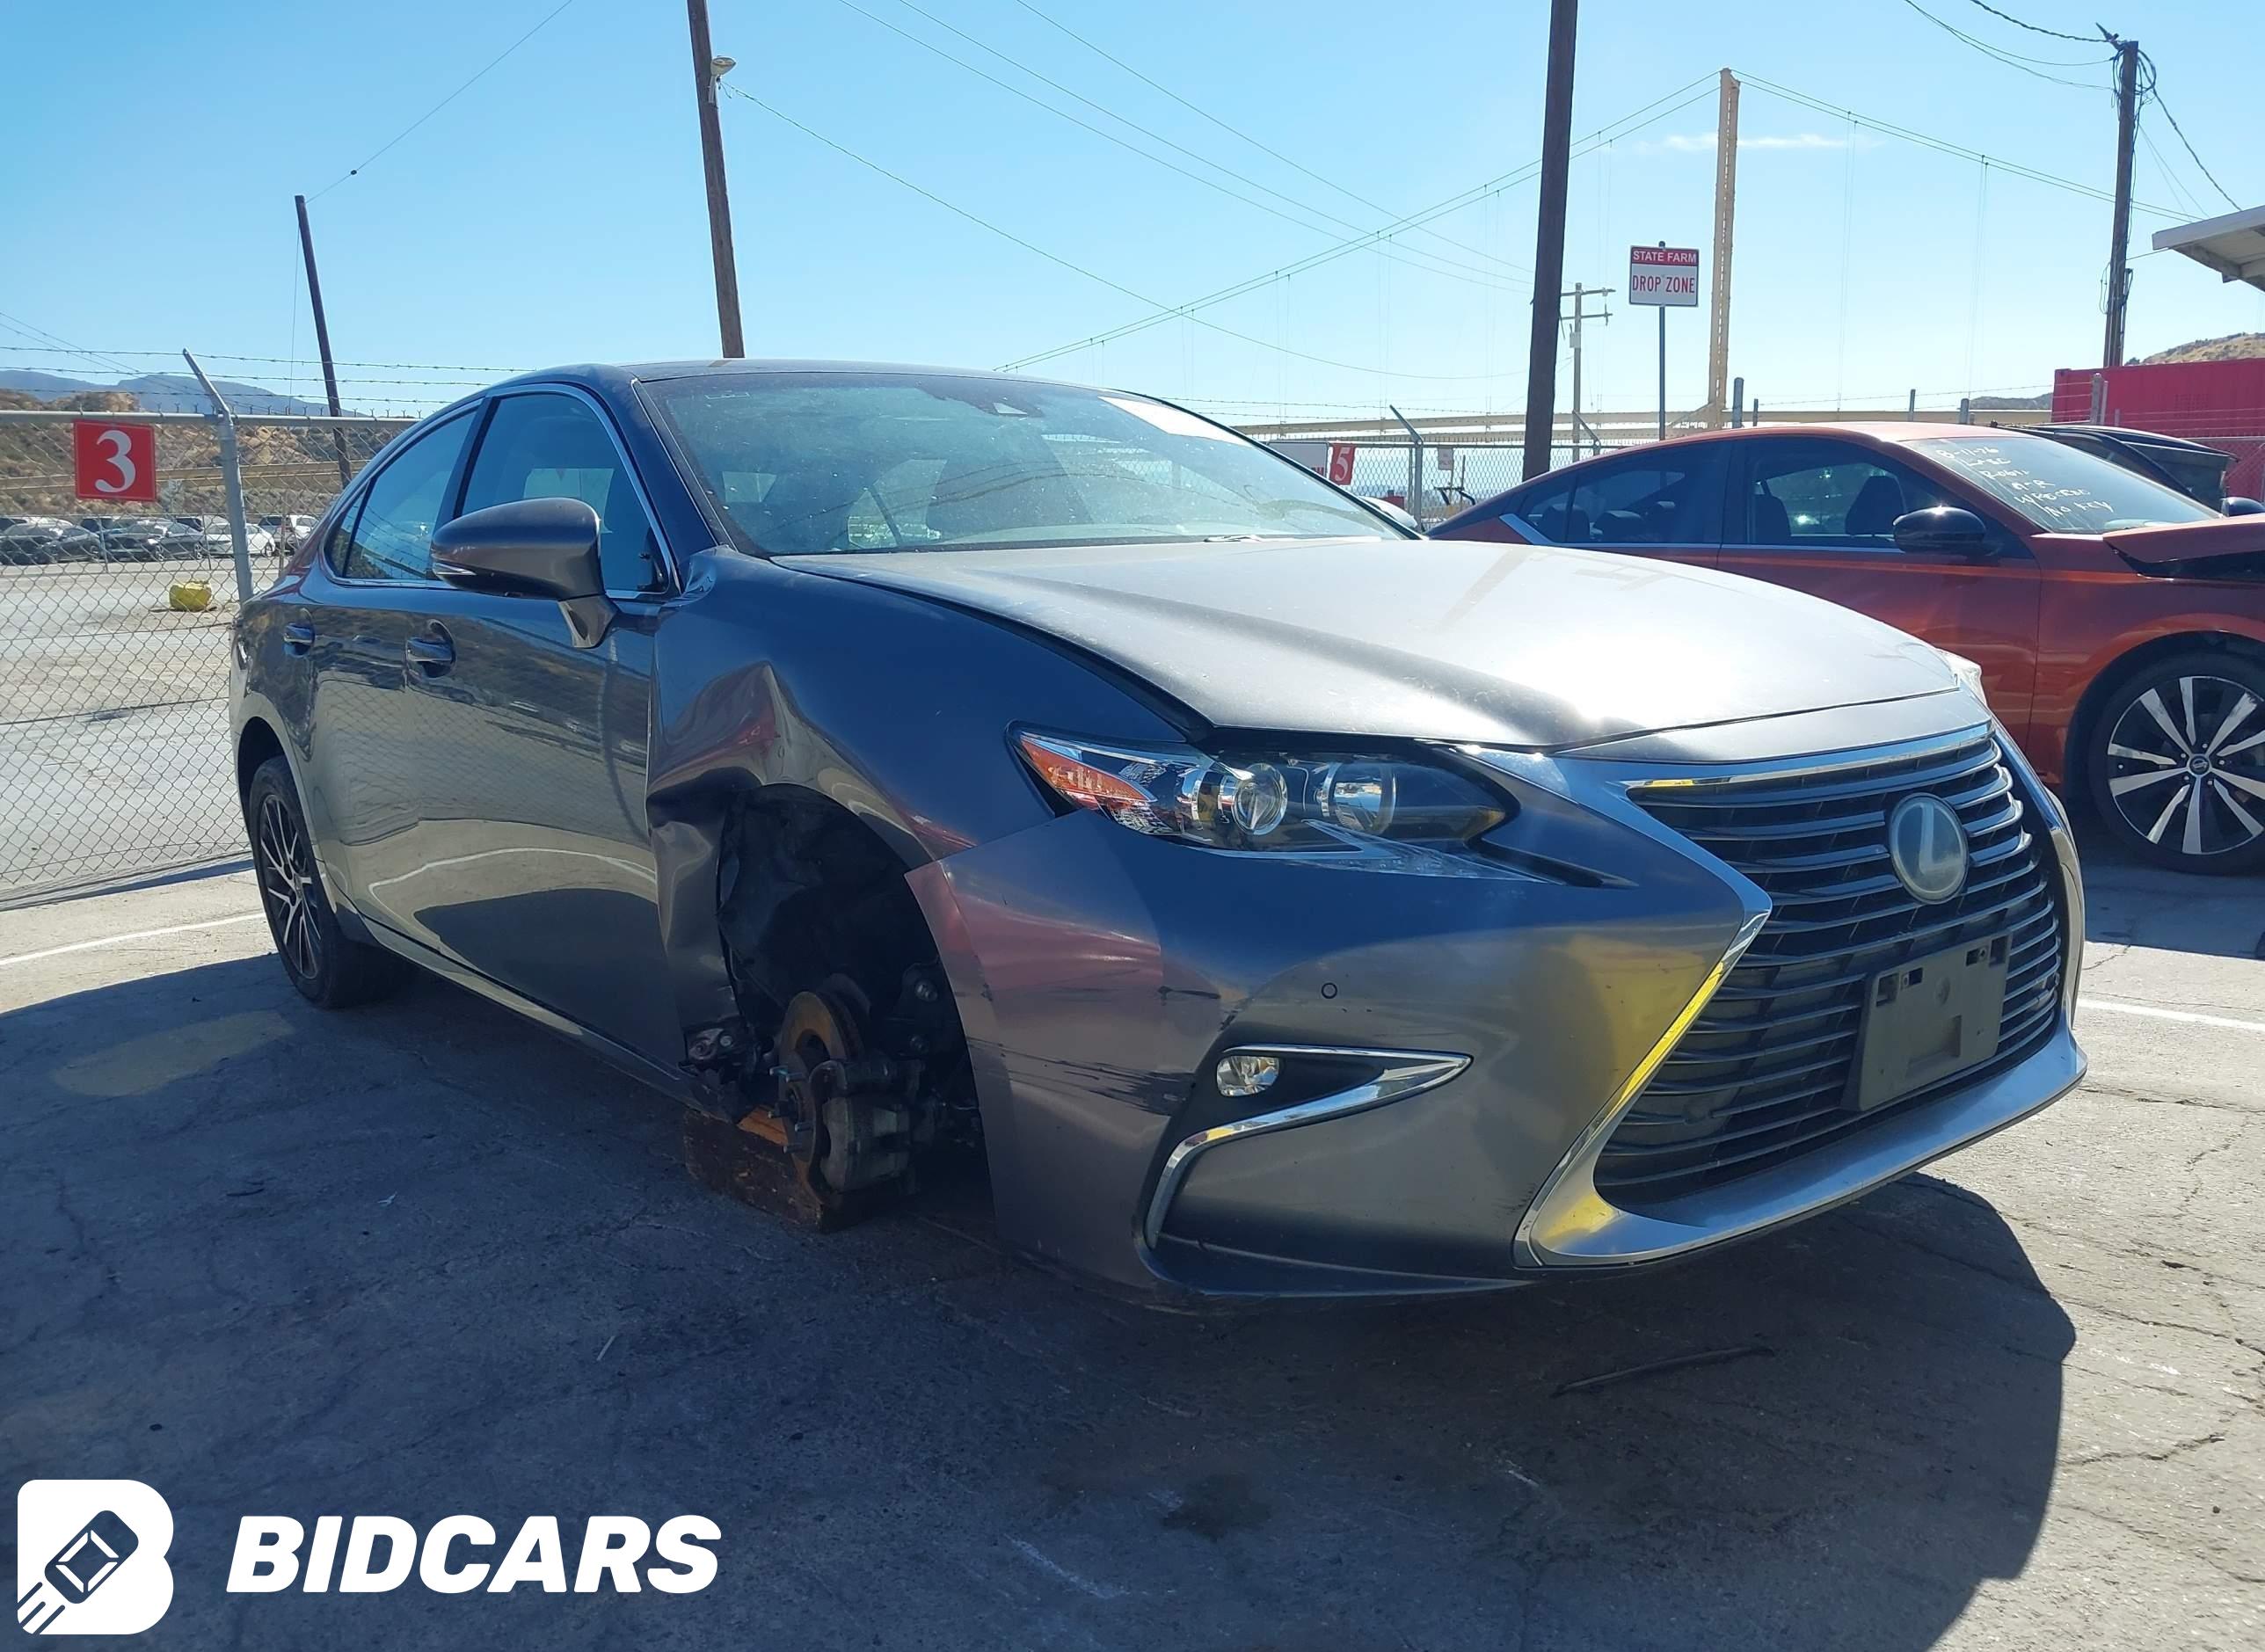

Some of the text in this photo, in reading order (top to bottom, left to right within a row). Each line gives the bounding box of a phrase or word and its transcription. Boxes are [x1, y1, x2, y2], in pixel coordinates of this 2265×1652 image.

[1633, 251, 1697, 263] STATE FARM
[1632, 275, 1695, 294] DROP ZONE
[94, 430, 136, 493] 3
[1334, 447, 1351, 482] 5
